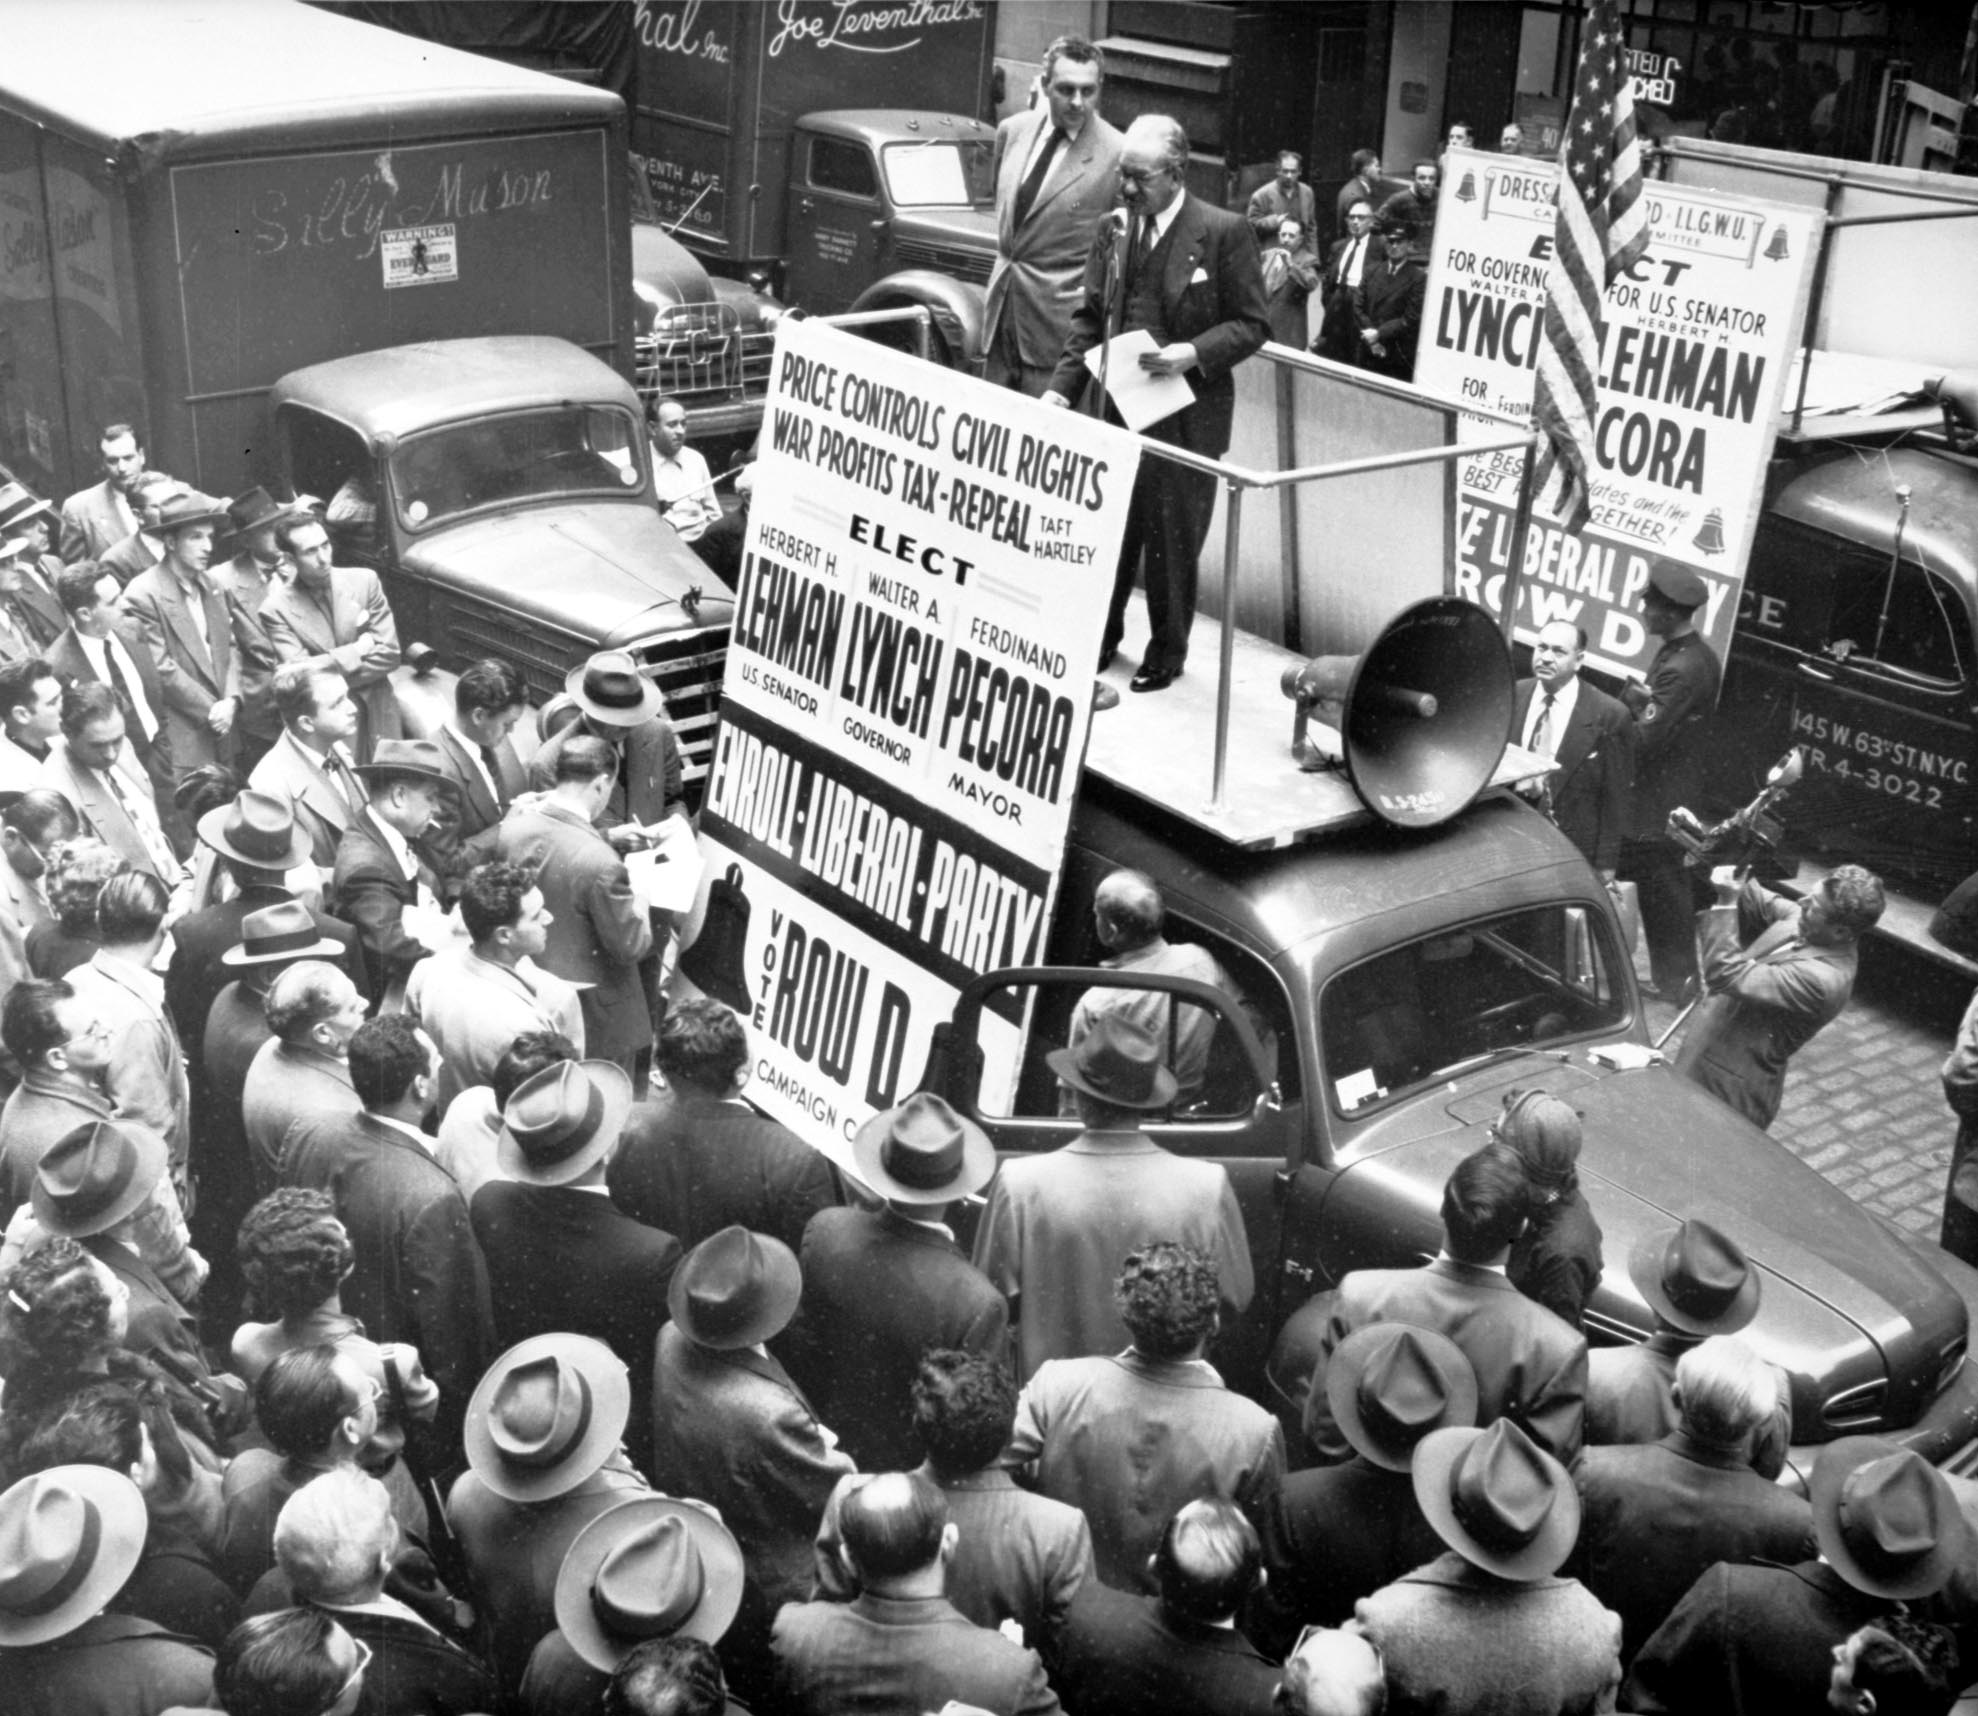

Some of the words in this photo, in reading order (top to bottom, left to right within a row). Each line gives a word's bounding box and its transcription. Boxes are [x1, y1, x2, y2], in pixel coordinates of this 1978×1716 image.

[634, 0, 699, 54] hal
[769, 0, 824, 56] Joe
[817, 0, 965, 52] Leventhal
[1447, 248, 1476, 274] FOR
[1528, 234, 1692, 286] ECT
[1471, 279, 1528, 299] WALTER
[1608, 282, 1641, 310] FOR
[1650, 291, 1678, 318] U.S.
[1683, 299, 1766, 337] SENATOR
[1637, 315, 1710, 338] HERBERT
[1462, 377, 1488, 400] FOR
[772, 407, 813, 463] WAR
[815, 424, 898, 496] PROFITS
[779, 350, 838, 412] PRICE
[840, 373, 946, 451] CONTROLS
[952, 412, 1011, 478] CIVIL
[1014, 433, 1109, 512] RIGHTS
[1595, 406, 1706, 495] CORA
[1463, 465, 1507, 491] BEST
[1488, 452, 1525, 477] BES
[1039, 515, 1074, 538] TAFT
[1590, 504, 1679, 545] GETHER!
[1633, 498, 1668, 515] and
[758, 523, 822, 569] HERBERT
[849, 513, 975, 587] ELECT
[1033, 540, 1097, 567] HARTLEY
[868, 570, 920, 615] WALTER
[733, 551, 846, 691] LEHMAN
[1600, 609, 1646, 657] D
[839, 600, 945, 741] LYNCH
[970, 616, 1067, 680] FERDINAND
[741, 663, 760, 687] U.S.
[761, 672, 819, 718] SENATOR
[843, 716, 912, 767] GOVERNOR
[938, 646, 1075, 805] PECORA
[1792, 708, 1829, 740] 145
[947, 772, 1023, 827] MAYOR
[752, 908, 784, 1031] VOTE
[769, 919, 870, 1087] ROW
[864, 980, 912, 1112] D
[756, 1058, 838, 1130] CAMPAIGN
[843, 1117, 857, 1143] C
